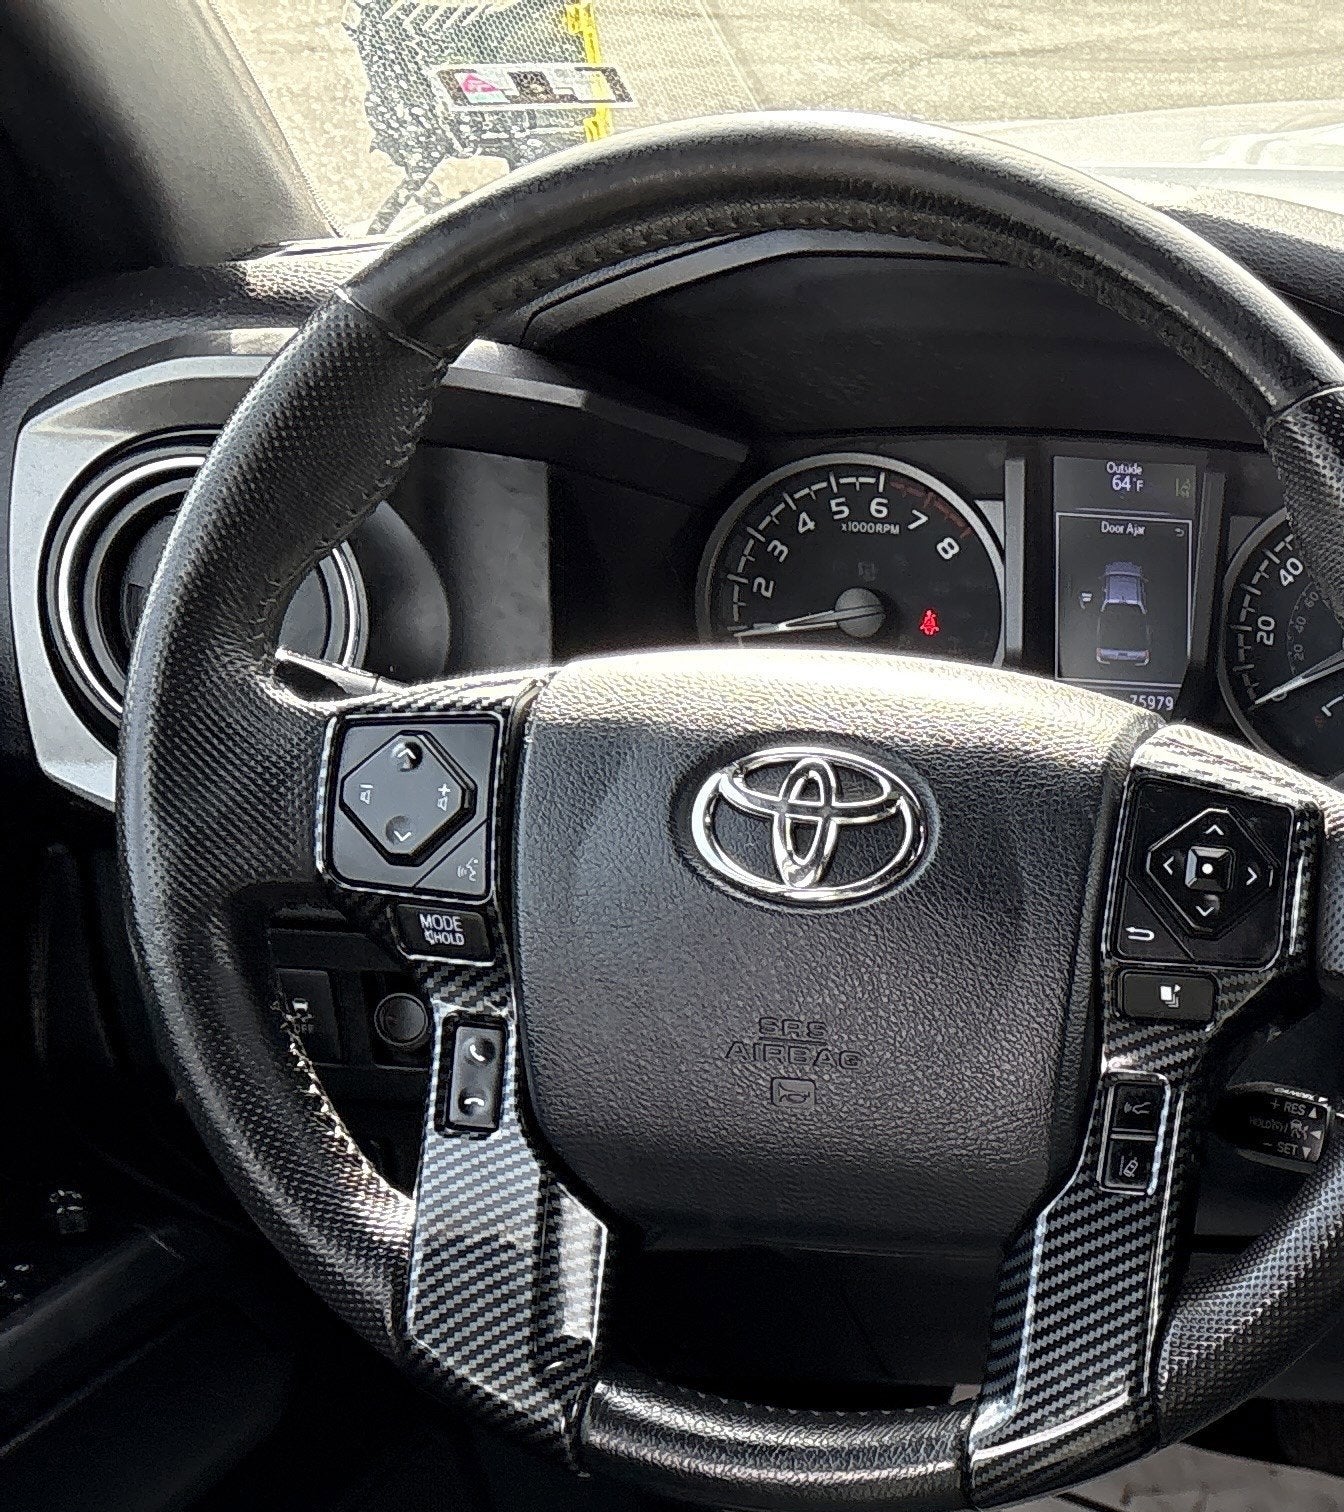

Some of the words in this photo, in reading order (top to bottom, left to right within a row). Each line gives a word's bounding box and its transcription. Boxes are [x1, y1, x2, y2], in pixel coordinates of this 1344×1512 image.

[1107, 461, 1143, 475] Outside
[830, 497, 850, 519] 5
[869, 498, 888, 518] 6
[798, 511, 815, 533] 4
[908, 510, 929, 530] 7
[1101, 521, 1124, 534] Door
[1126, 522, 1146, 537] Ajar
[767, 539, 789, 562] 3
[936, 537, 960, 559] 8
[1279, 557, 1304, 587] 40
[753, 577, 774, 598] 2
[1257, 615, 1276, 646] 20
[419, 913, 463, 932] MODE
[433, 931, 465, 947] HOLD
[758, 1017, 829, 1039] SRS
[725, 1041, 862, 1070] AIRBAG
